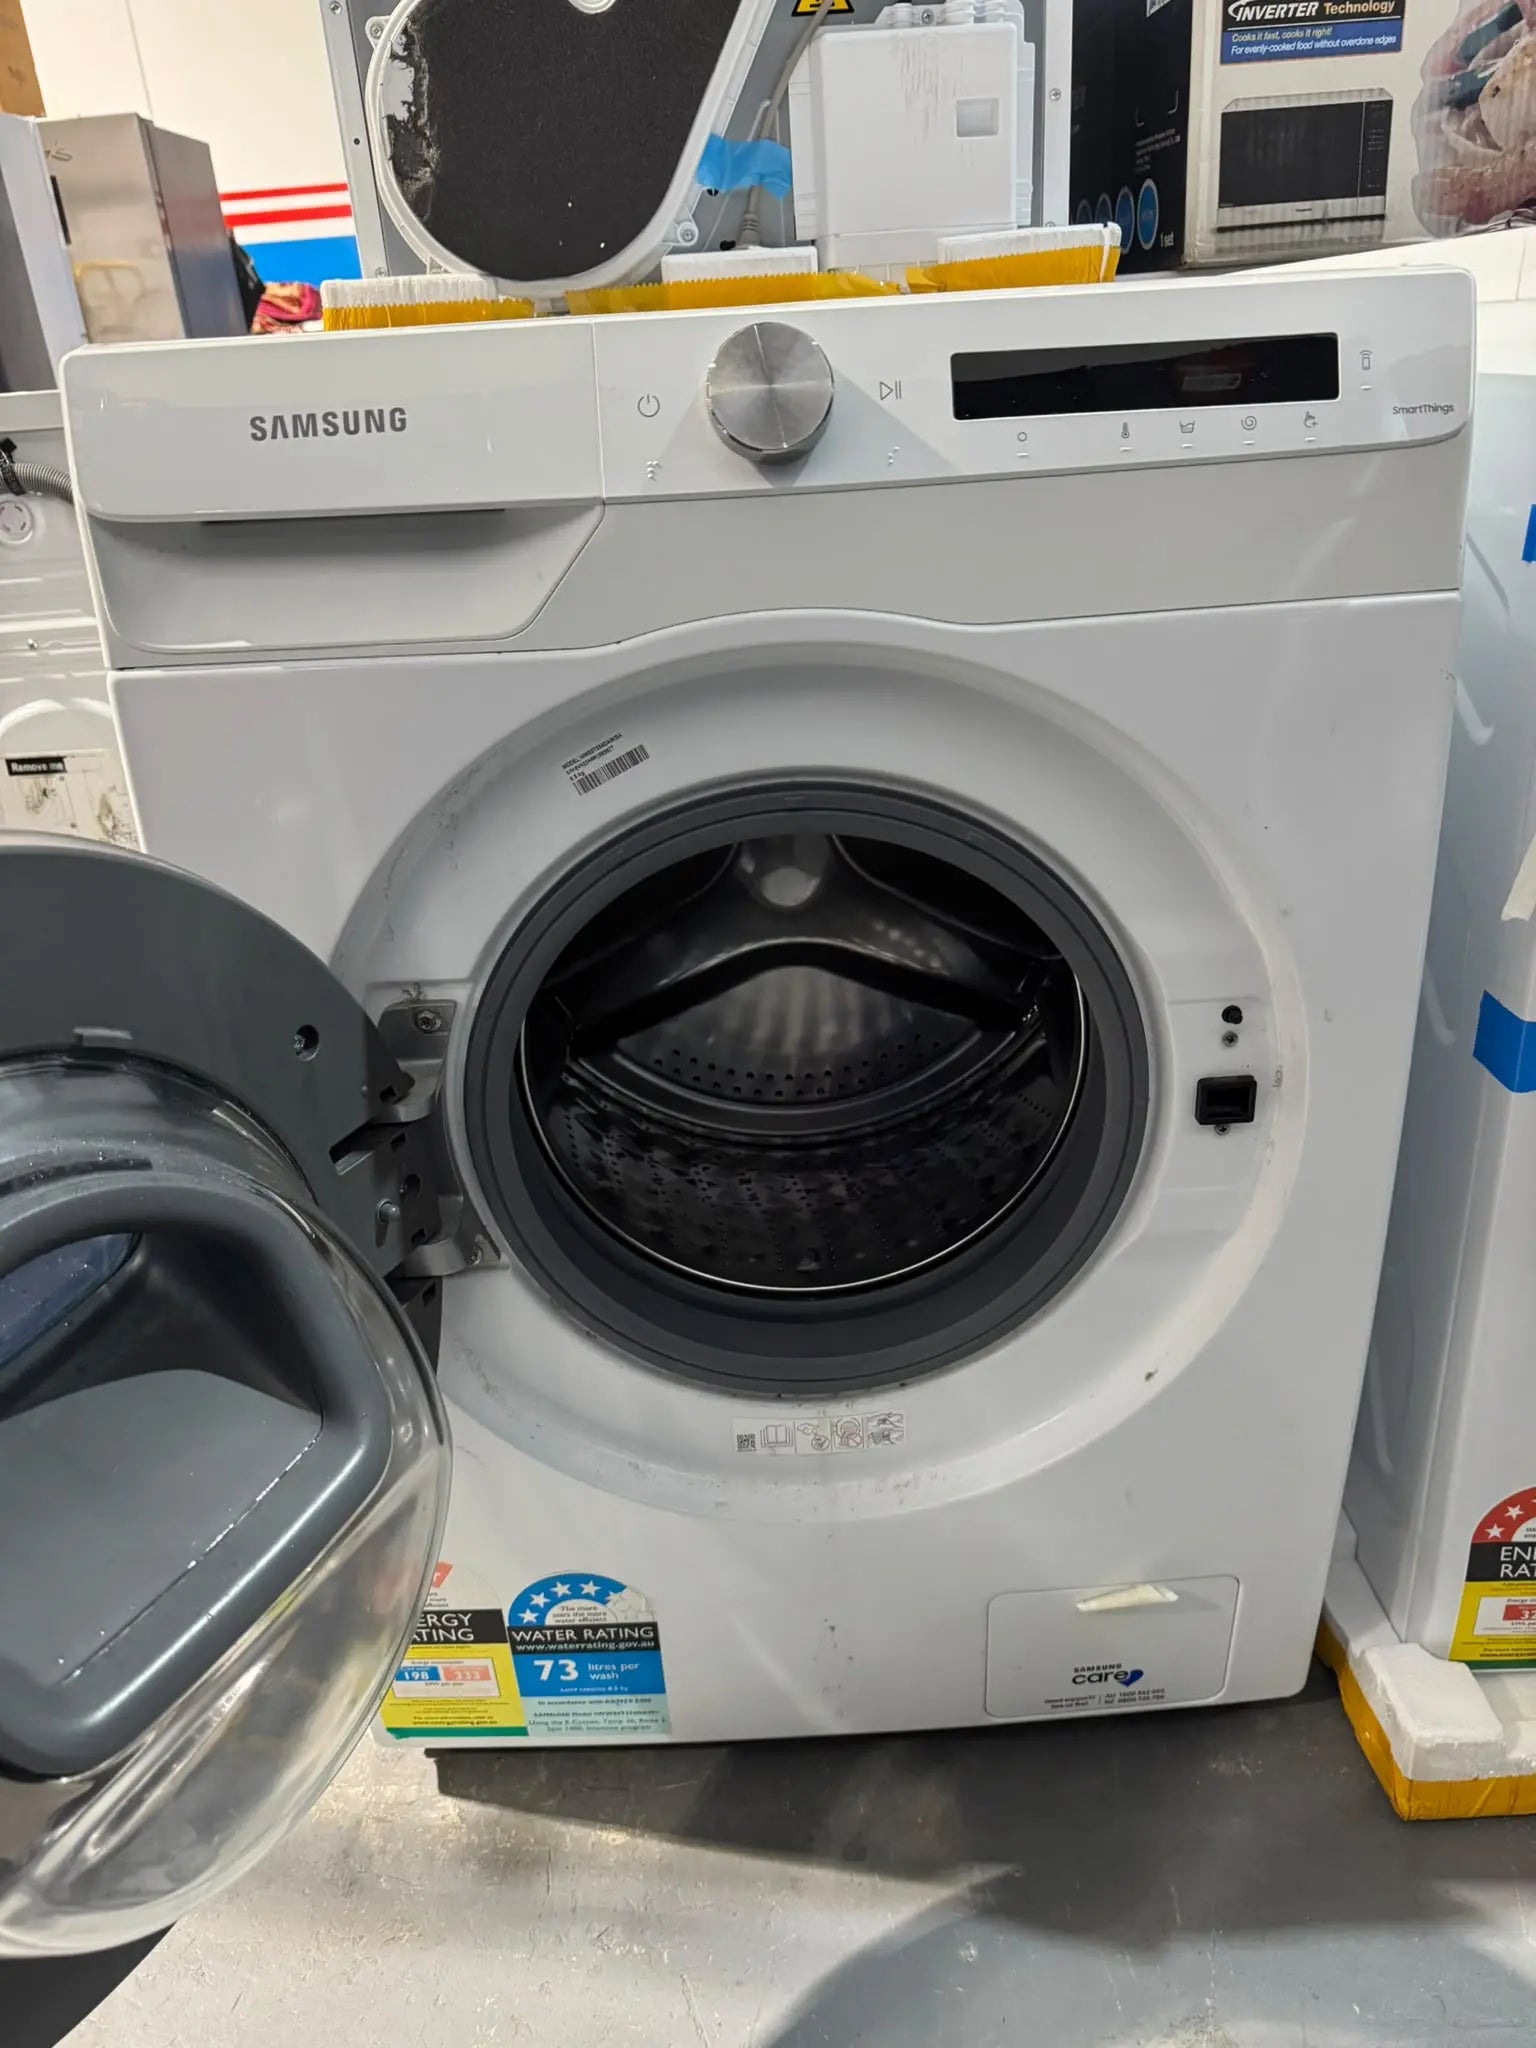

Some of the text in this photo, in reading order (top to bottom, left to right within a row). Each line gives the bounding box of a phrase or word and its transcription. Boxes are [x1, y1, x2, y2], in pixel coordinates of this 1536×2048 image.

[1235, 0, 1395, 22] INVERTER Technology
[1231, 33, 1257, 42] Cooks
[1257, 32, 1264, 41] it
[1281, 29, 1304, 39] cooks
[1304, 29, 1311, 38] it
[1231, 35, 1397, 55] For evenly-cooked food without overdone edges
[1391, 403, 1456, 416] SmartThings
[249, 406, 407, 442] SAMSUNG
[11, 761, 48, 774] Remove
[416, 1613, 472, 1627] ERGY
[511, 1626, 655, 1642] WATER RATING
[515, 1641, 655, 1651] www.waterrating.gov.au
[533, 1658, 640, 1682] 73 litres per
[1073, 1663, 1122, 1674] SAMSUNG
[403, 1670, 430, 1681] 198
[589, 1671, 620, 1681] wash
[1071, 1669, 1129, 1686] care
